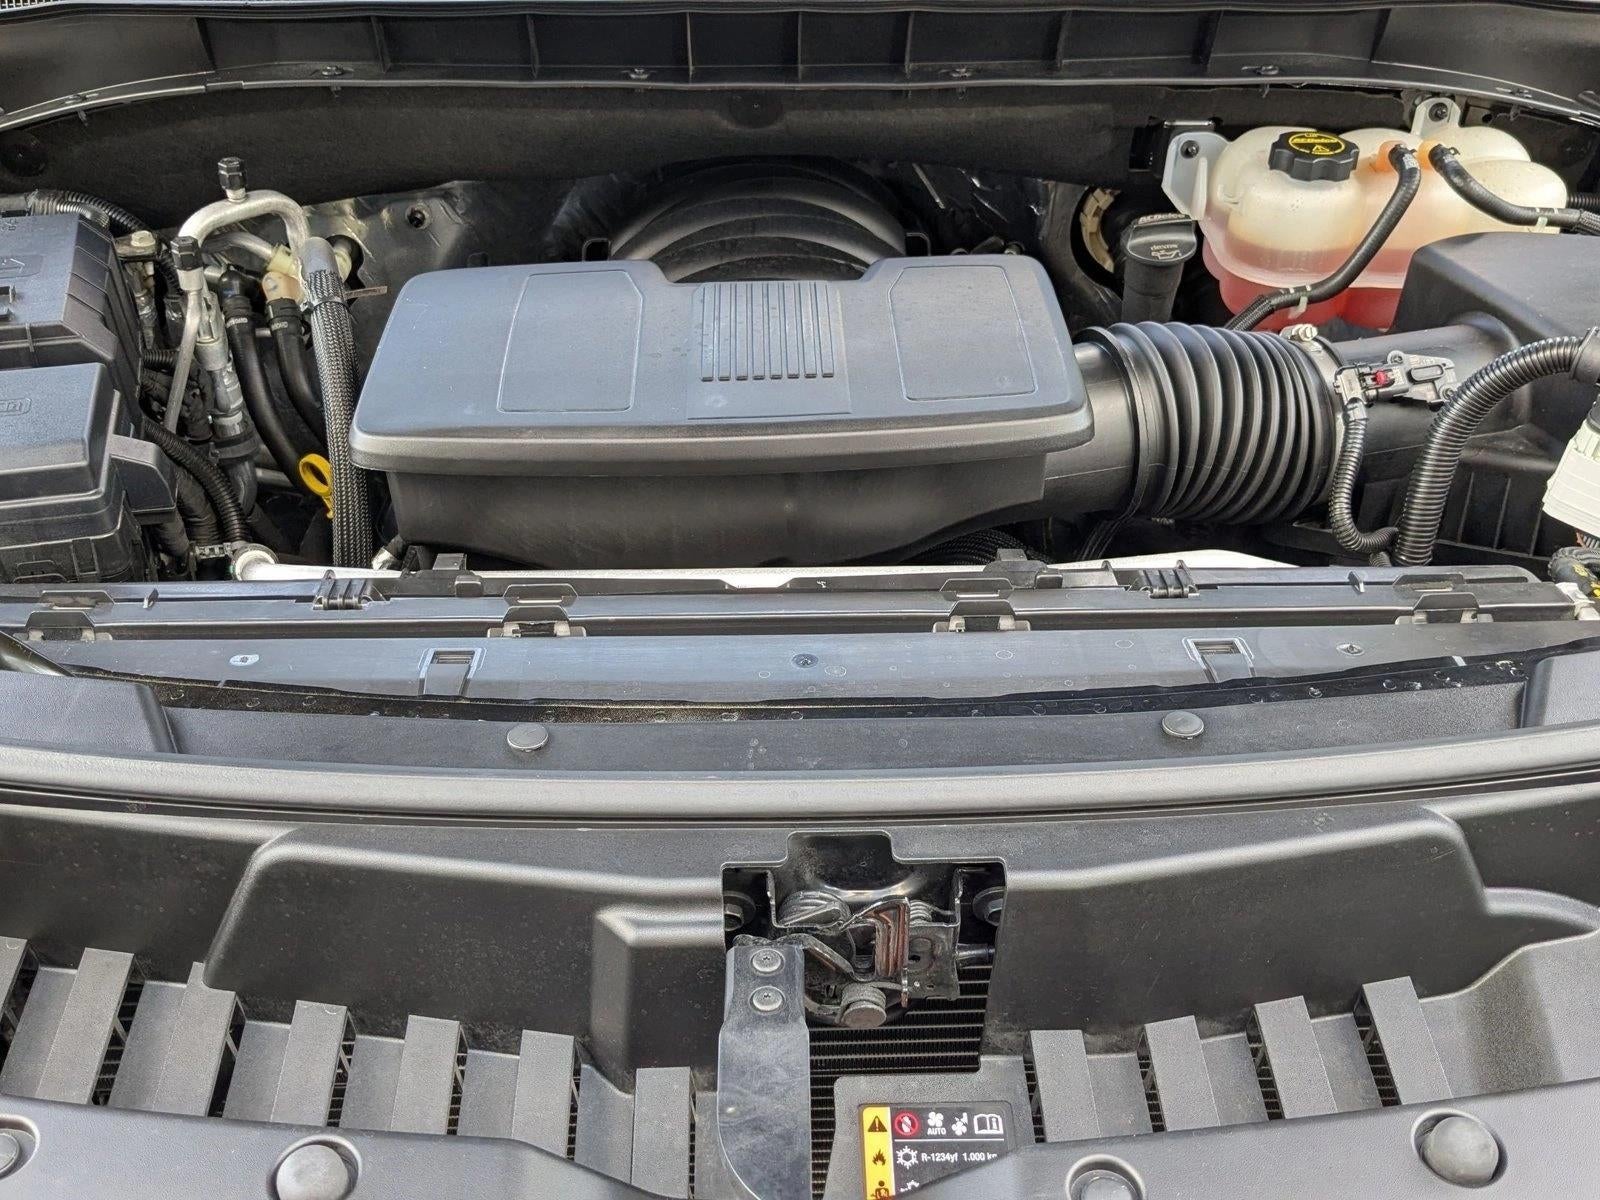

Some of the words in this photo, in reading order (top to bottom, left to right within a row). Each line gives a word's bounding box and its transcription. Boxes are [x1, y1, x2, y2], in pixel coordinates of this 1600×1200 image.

[927, 1127, 947, 1135] AUTO
[921, 1152, 958, 1163] R-1234yf
[962, 1152, 986, 1161] 1.000
